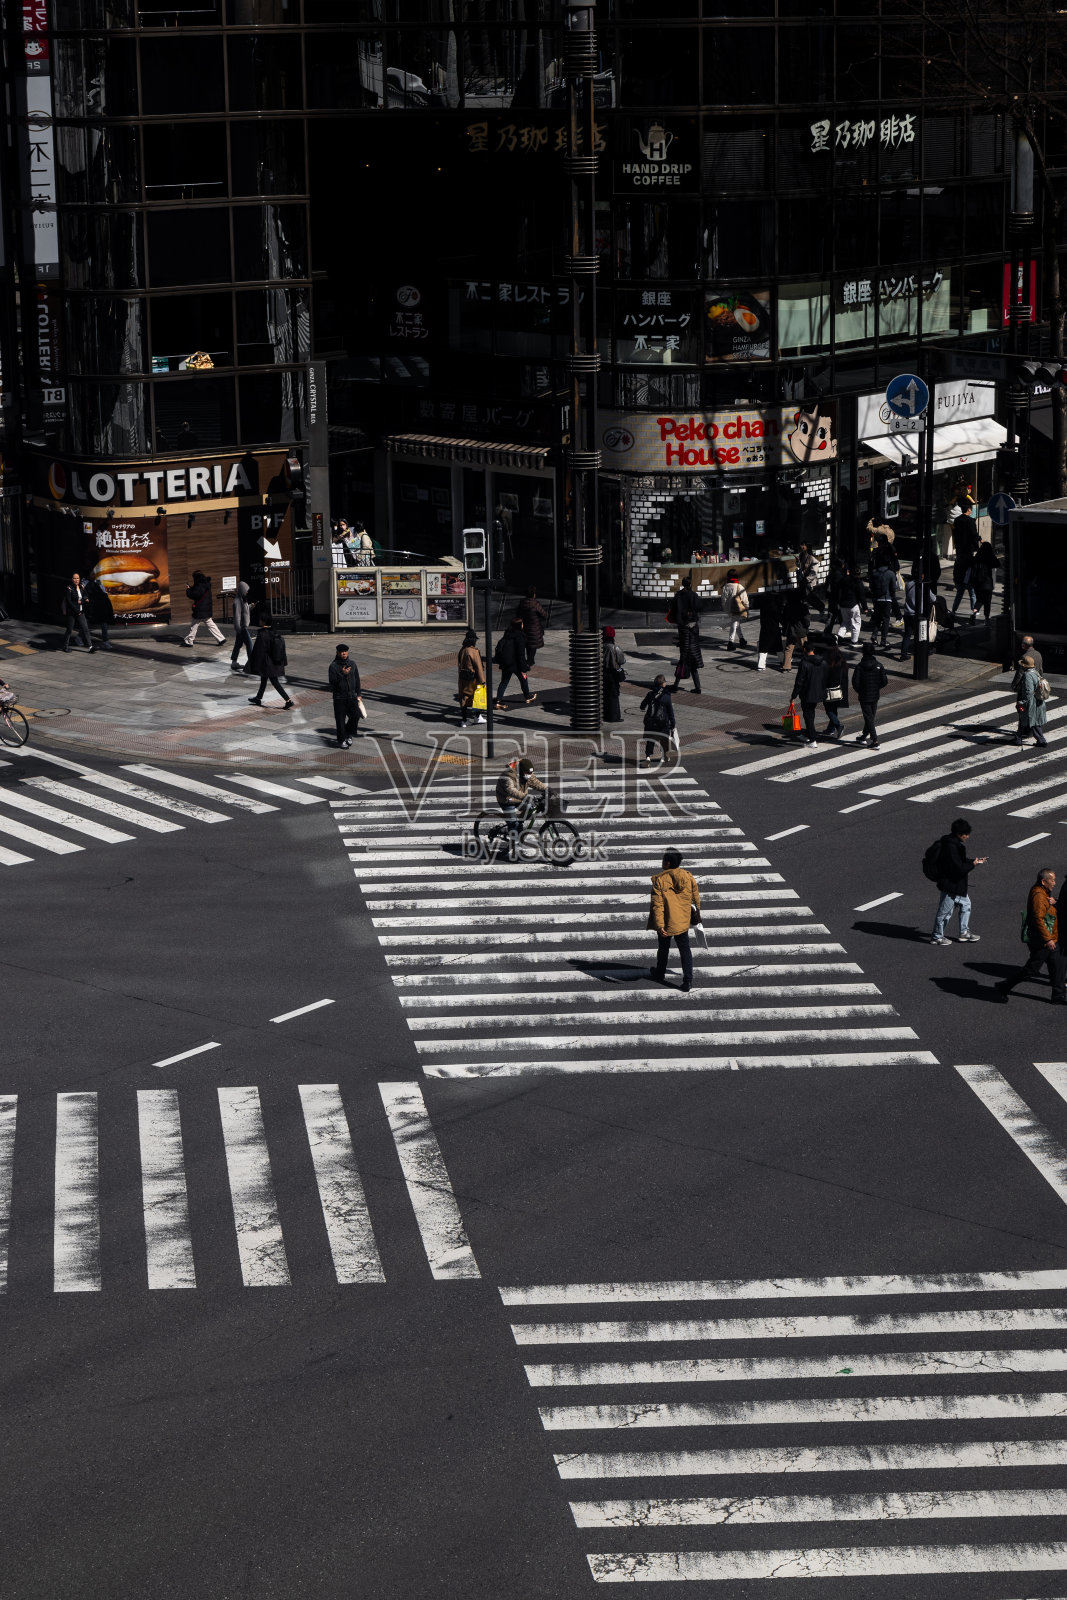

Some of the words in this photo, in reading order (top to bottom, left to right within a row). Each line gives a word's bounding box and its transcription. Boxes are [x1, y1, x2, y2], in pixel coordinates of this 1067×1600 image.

[809, 113, 917, 153] 星乃珈琲店
[622, 163, 659, 174] HAND
[661, 163, 693, 174] DRIP
[633, 175, 681, 186] COFFEE
[641, 290, 672, 306] 銀座
[395, 312, 423, 326] 不二家
[623, 312, 691, 327] ハンバーグ
[389, 325, 430, 339] レストラン
[633, 335, 680, 350] 不二家
[309, 384, 317, 412] CRYSTAL
[937, 392, 976, 409] FUJIYA
[656, 417, 719, 442] Peko
[722, 415, 780, 440] chan
[666, 442, 741, 466] House
[742, 445, 774, 454] ペコちゃん
[745, 454, 771, 463] のおうち
[71, 463, 252, 503] LOTTERIA
[250, 512, 285, 530] B1F
[95, 530, 131, 548] 絶品
[130, 532, 150, 541] チーズ
[131, 540, 154, 548] バーガー
